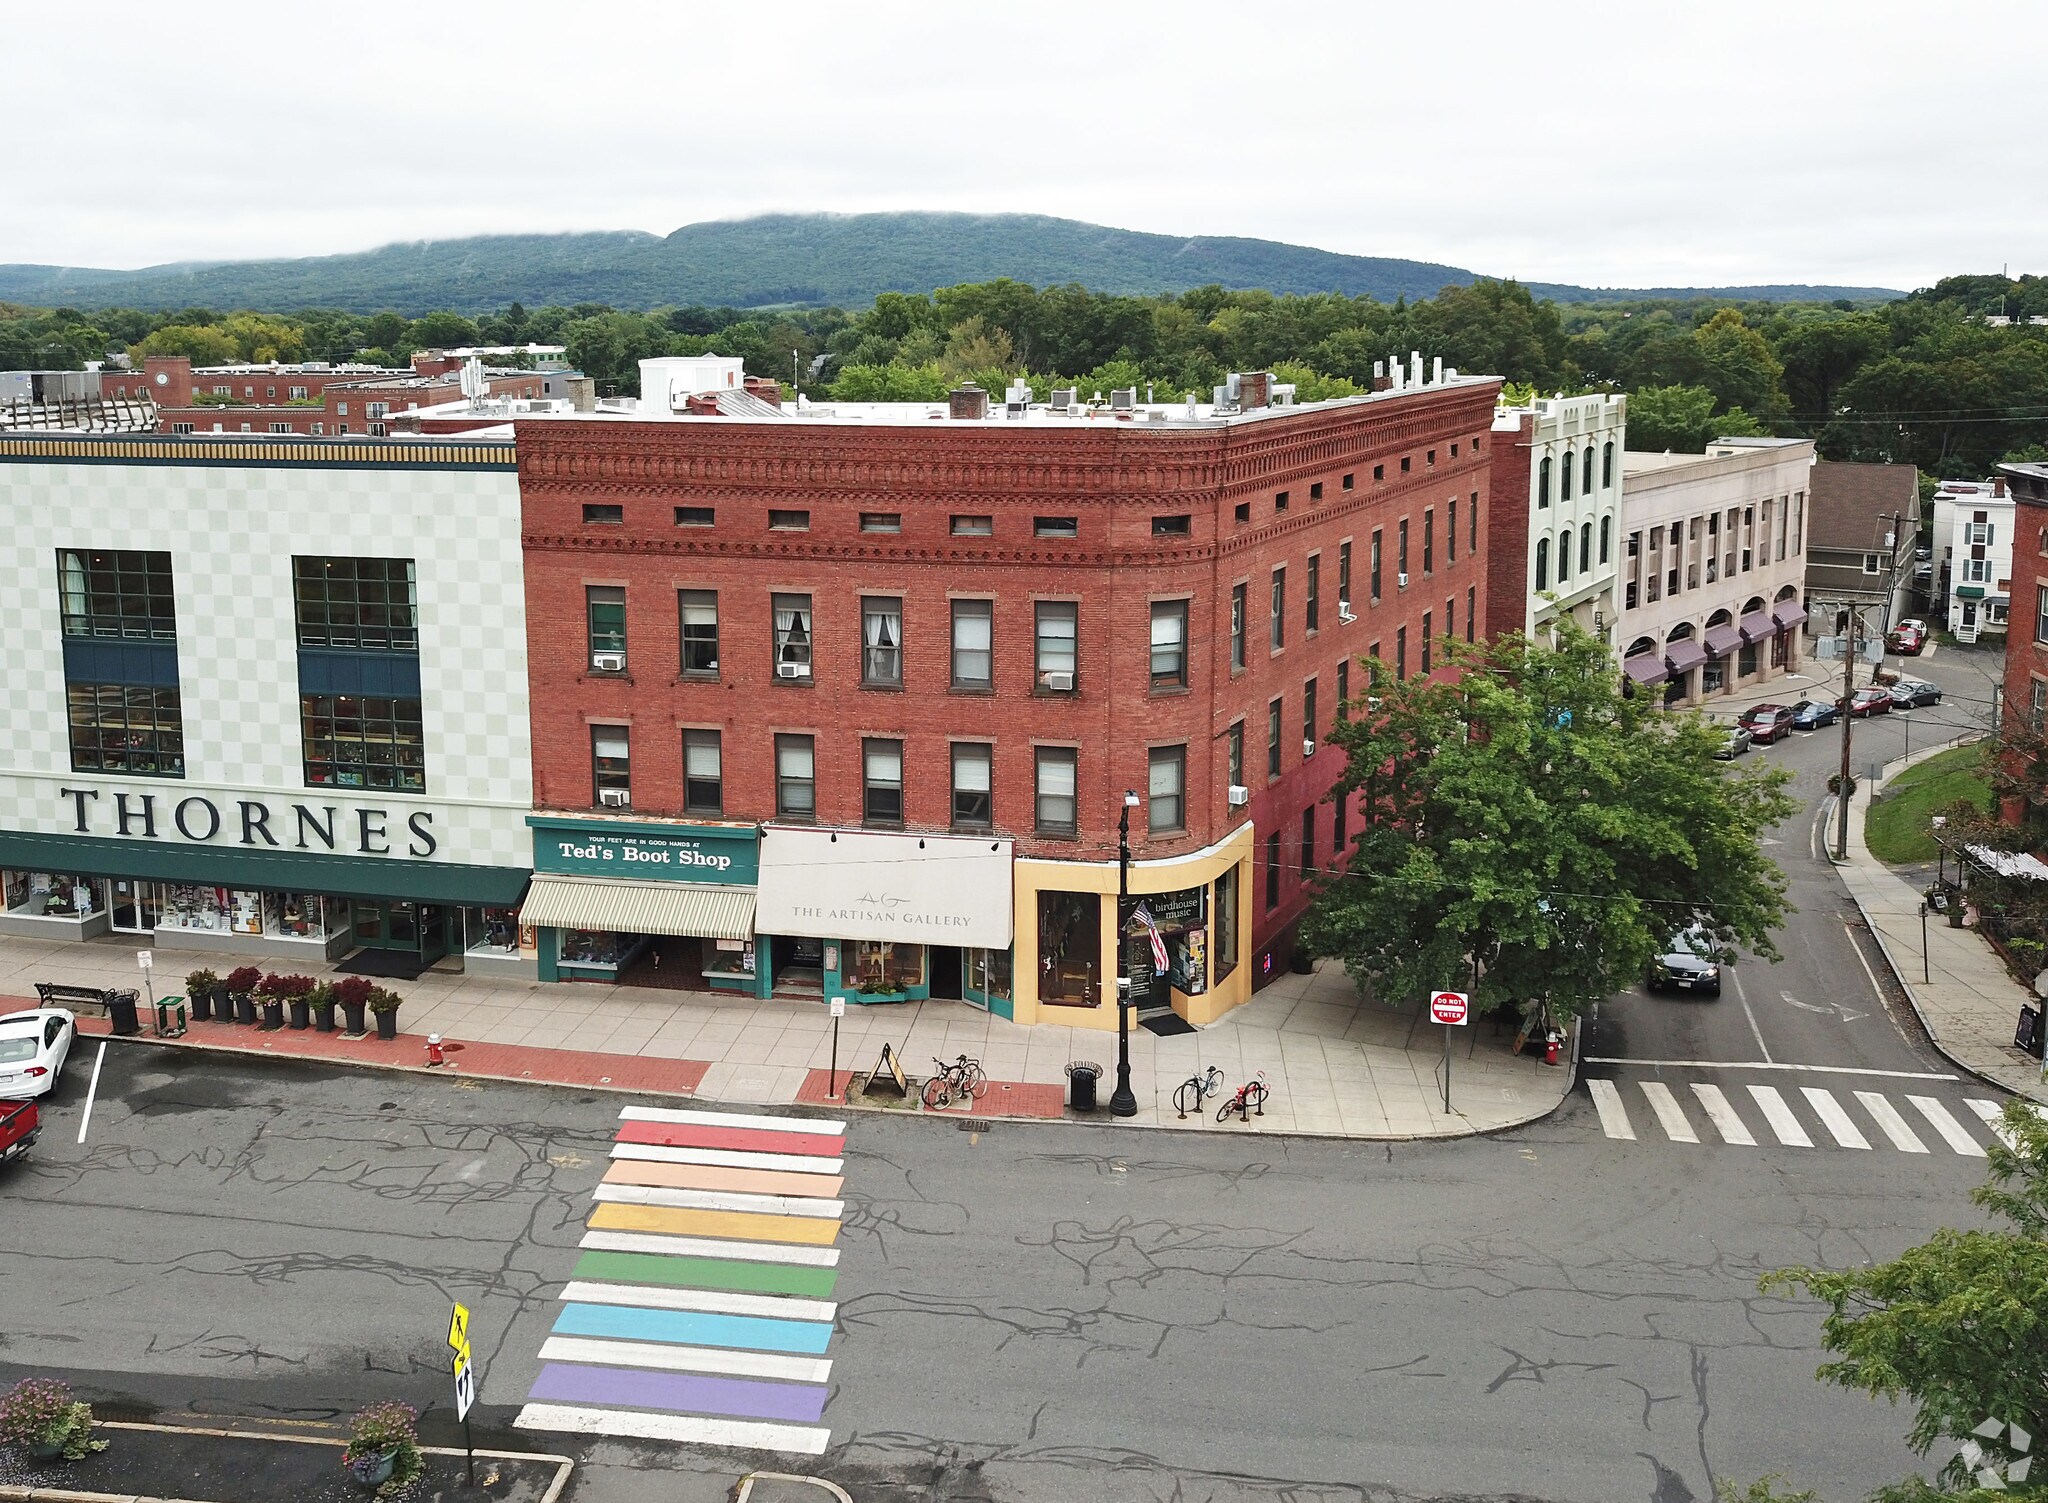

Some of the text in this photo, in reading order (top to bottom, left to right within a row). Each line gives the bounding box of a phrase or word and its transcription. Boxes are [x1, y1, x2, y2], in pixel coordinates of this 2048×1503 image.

[60, 787, 437, 857] THORNES
[558, 842, 731, 871] Ted's Boot Shop
[855, 890, 911, 908] AG
[1155, 900, 1198, 912] birdhouse
[792, 906, 971, 927] THE ARTISAN GALLERY
[1165, 908, 1191, 919] music
